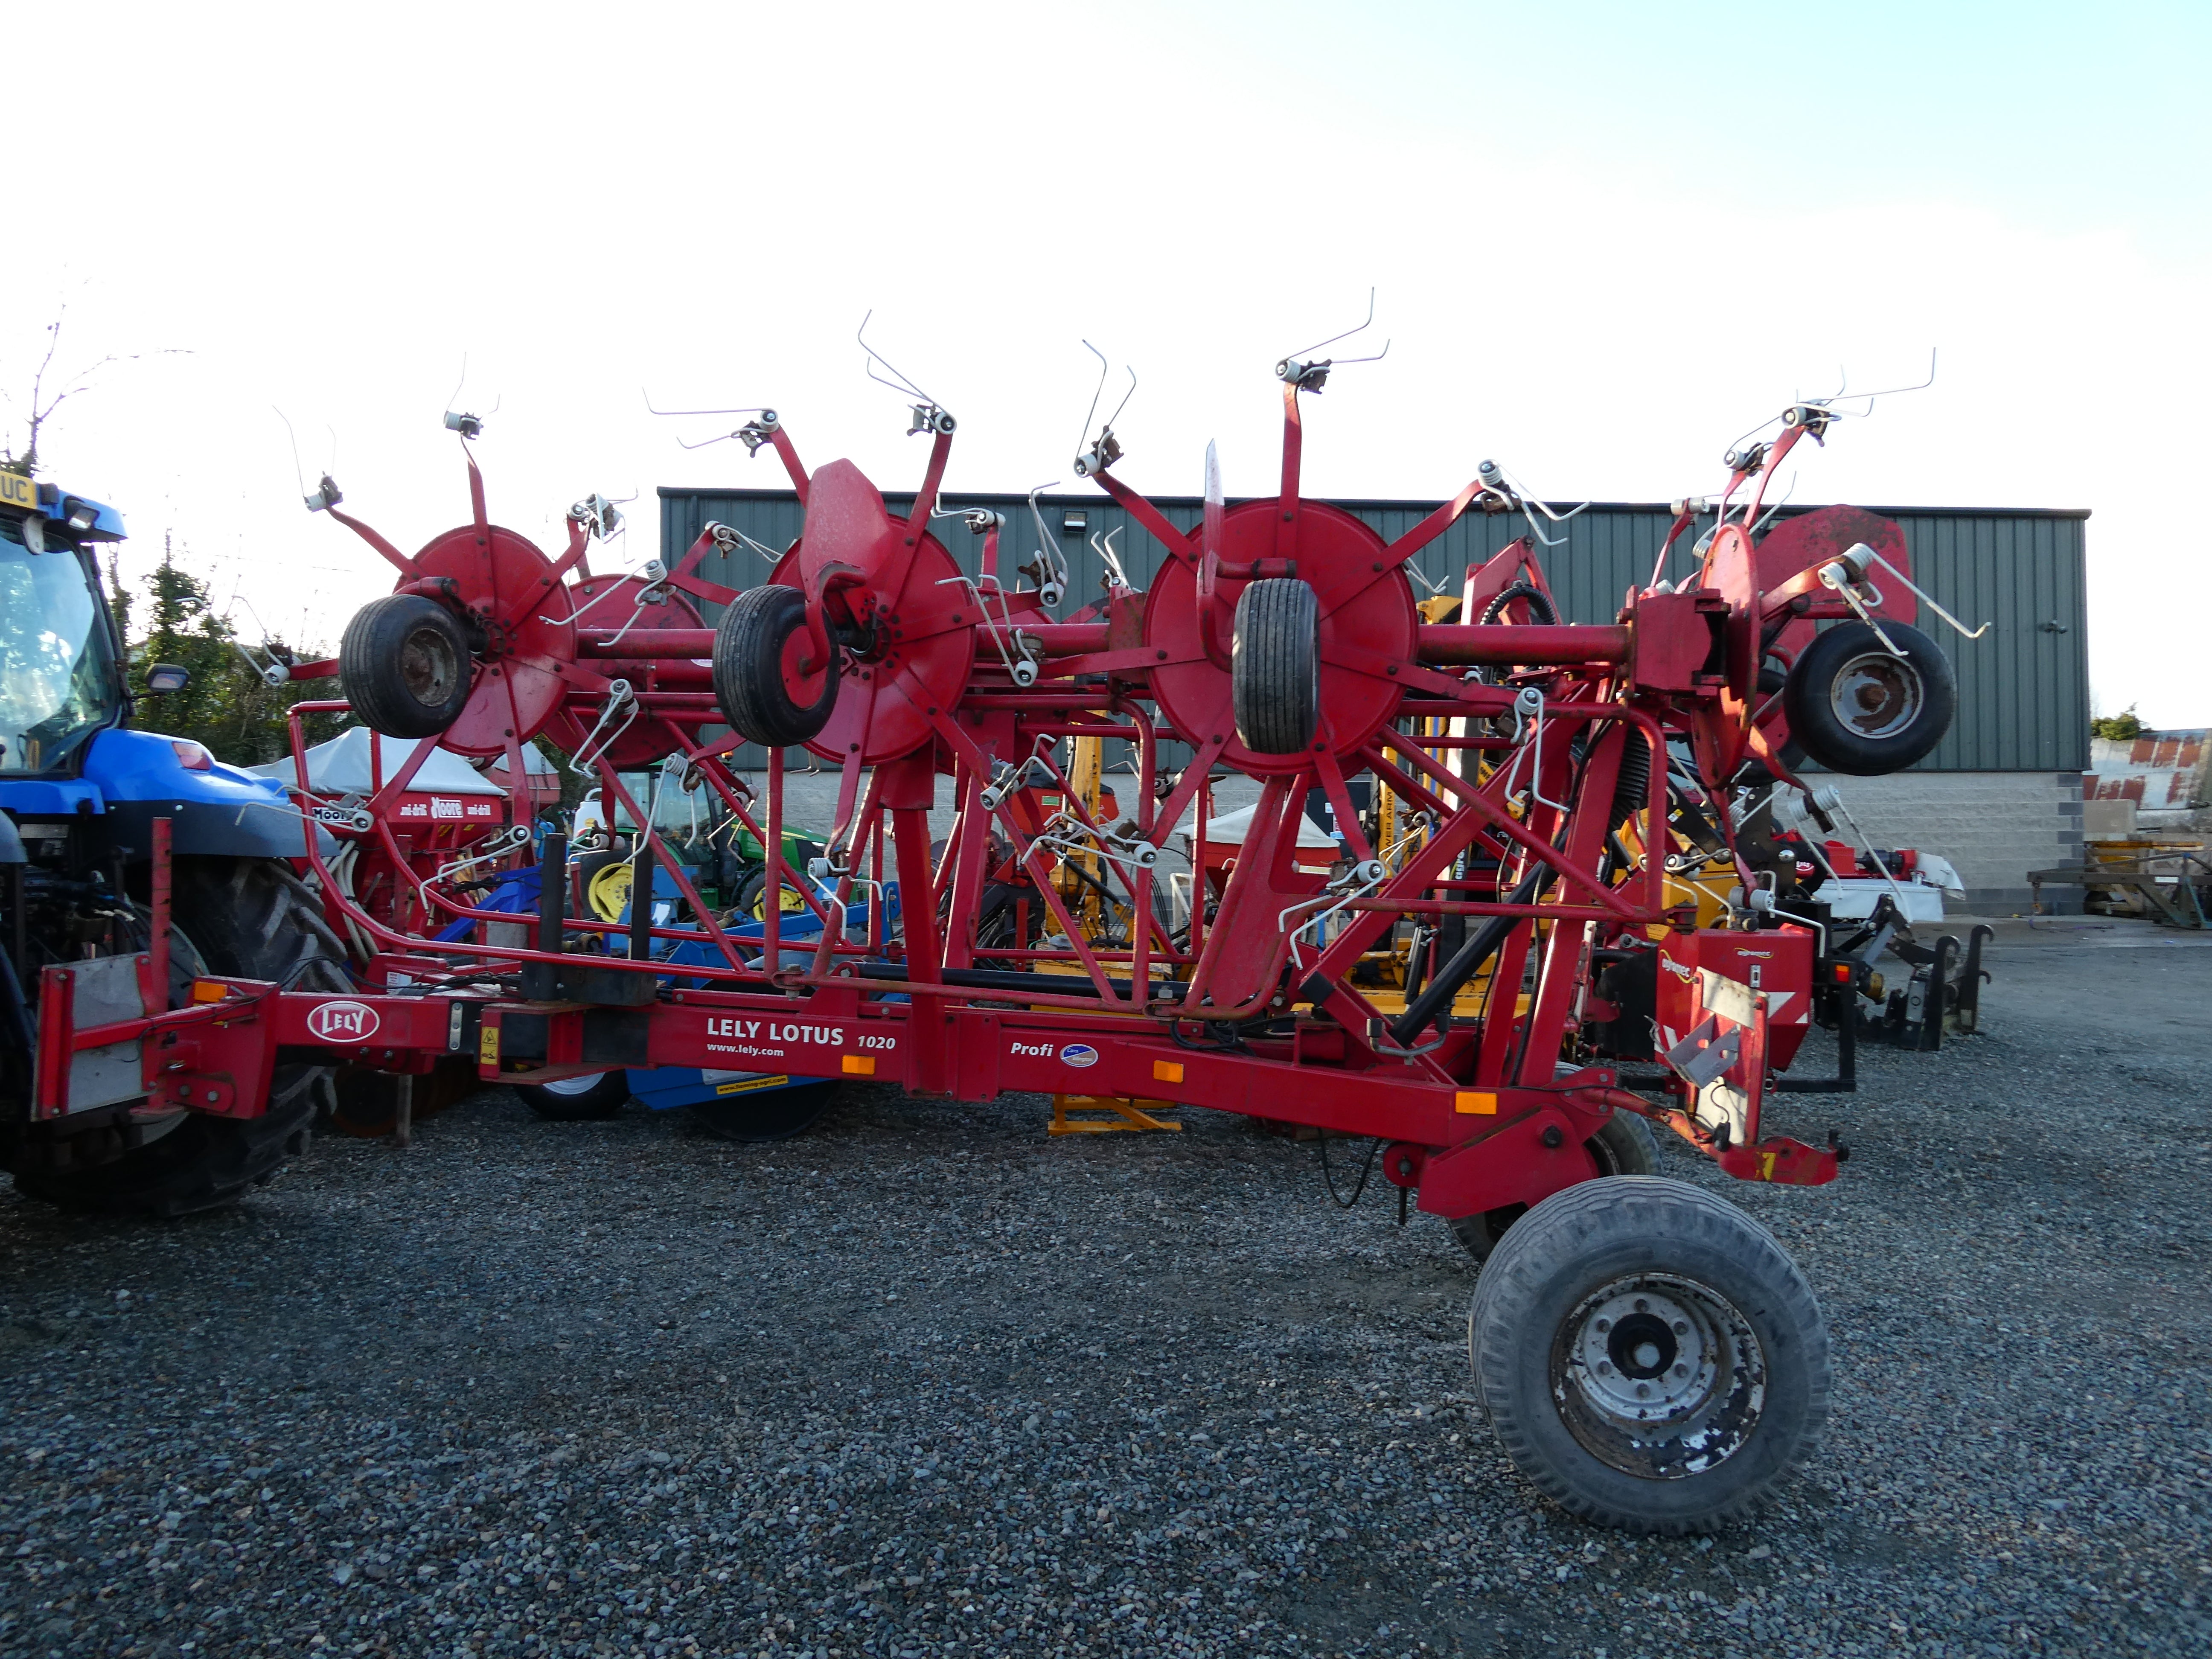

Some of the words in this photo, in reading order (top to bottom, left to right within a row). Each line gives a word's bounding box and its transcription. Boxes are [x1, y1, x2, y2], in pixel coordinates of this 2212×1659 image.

[322, 1009, 365, 1034] LELY
[707, 1018, 761, 1038] LELY
[769, 1023, 844, 1045] LOTUS
[857, 1036, 896, 1050] 1020
[707, 1043, 784, 1057] www.lely.com
[1010, 1042, 1054, 1057] Profi
